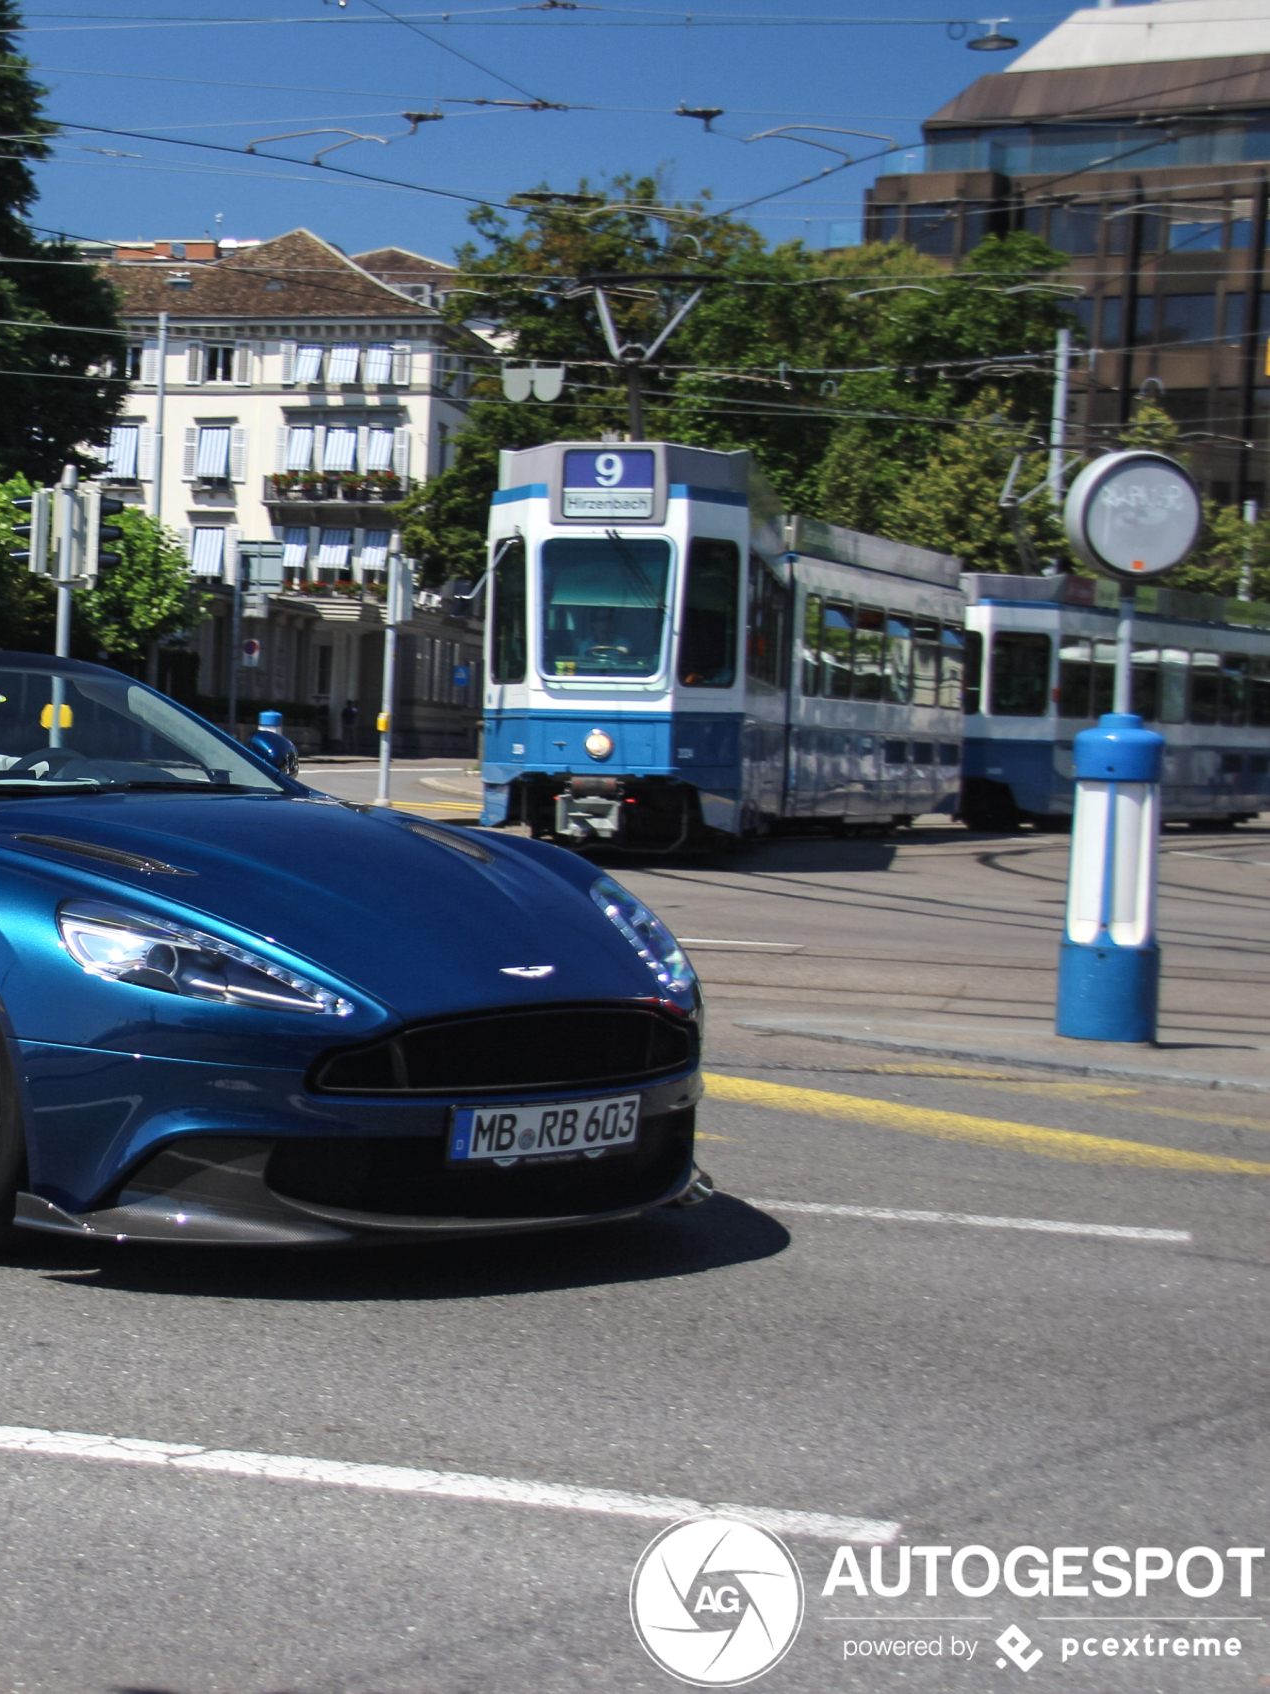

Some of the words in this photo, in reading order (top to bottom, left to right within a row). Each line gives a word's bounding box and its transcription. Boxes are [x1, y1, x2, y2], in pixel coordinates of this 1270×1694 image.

[595, 453, 623, 487] 9
[567, 498, 648, 511] Hirzenbach
[472, 1113, 517, 1152] MB
[537, 1109, 579, 1148] RB
[583, 1100, 636, 1143] 603
[456, 1139, 465, 1150] D
